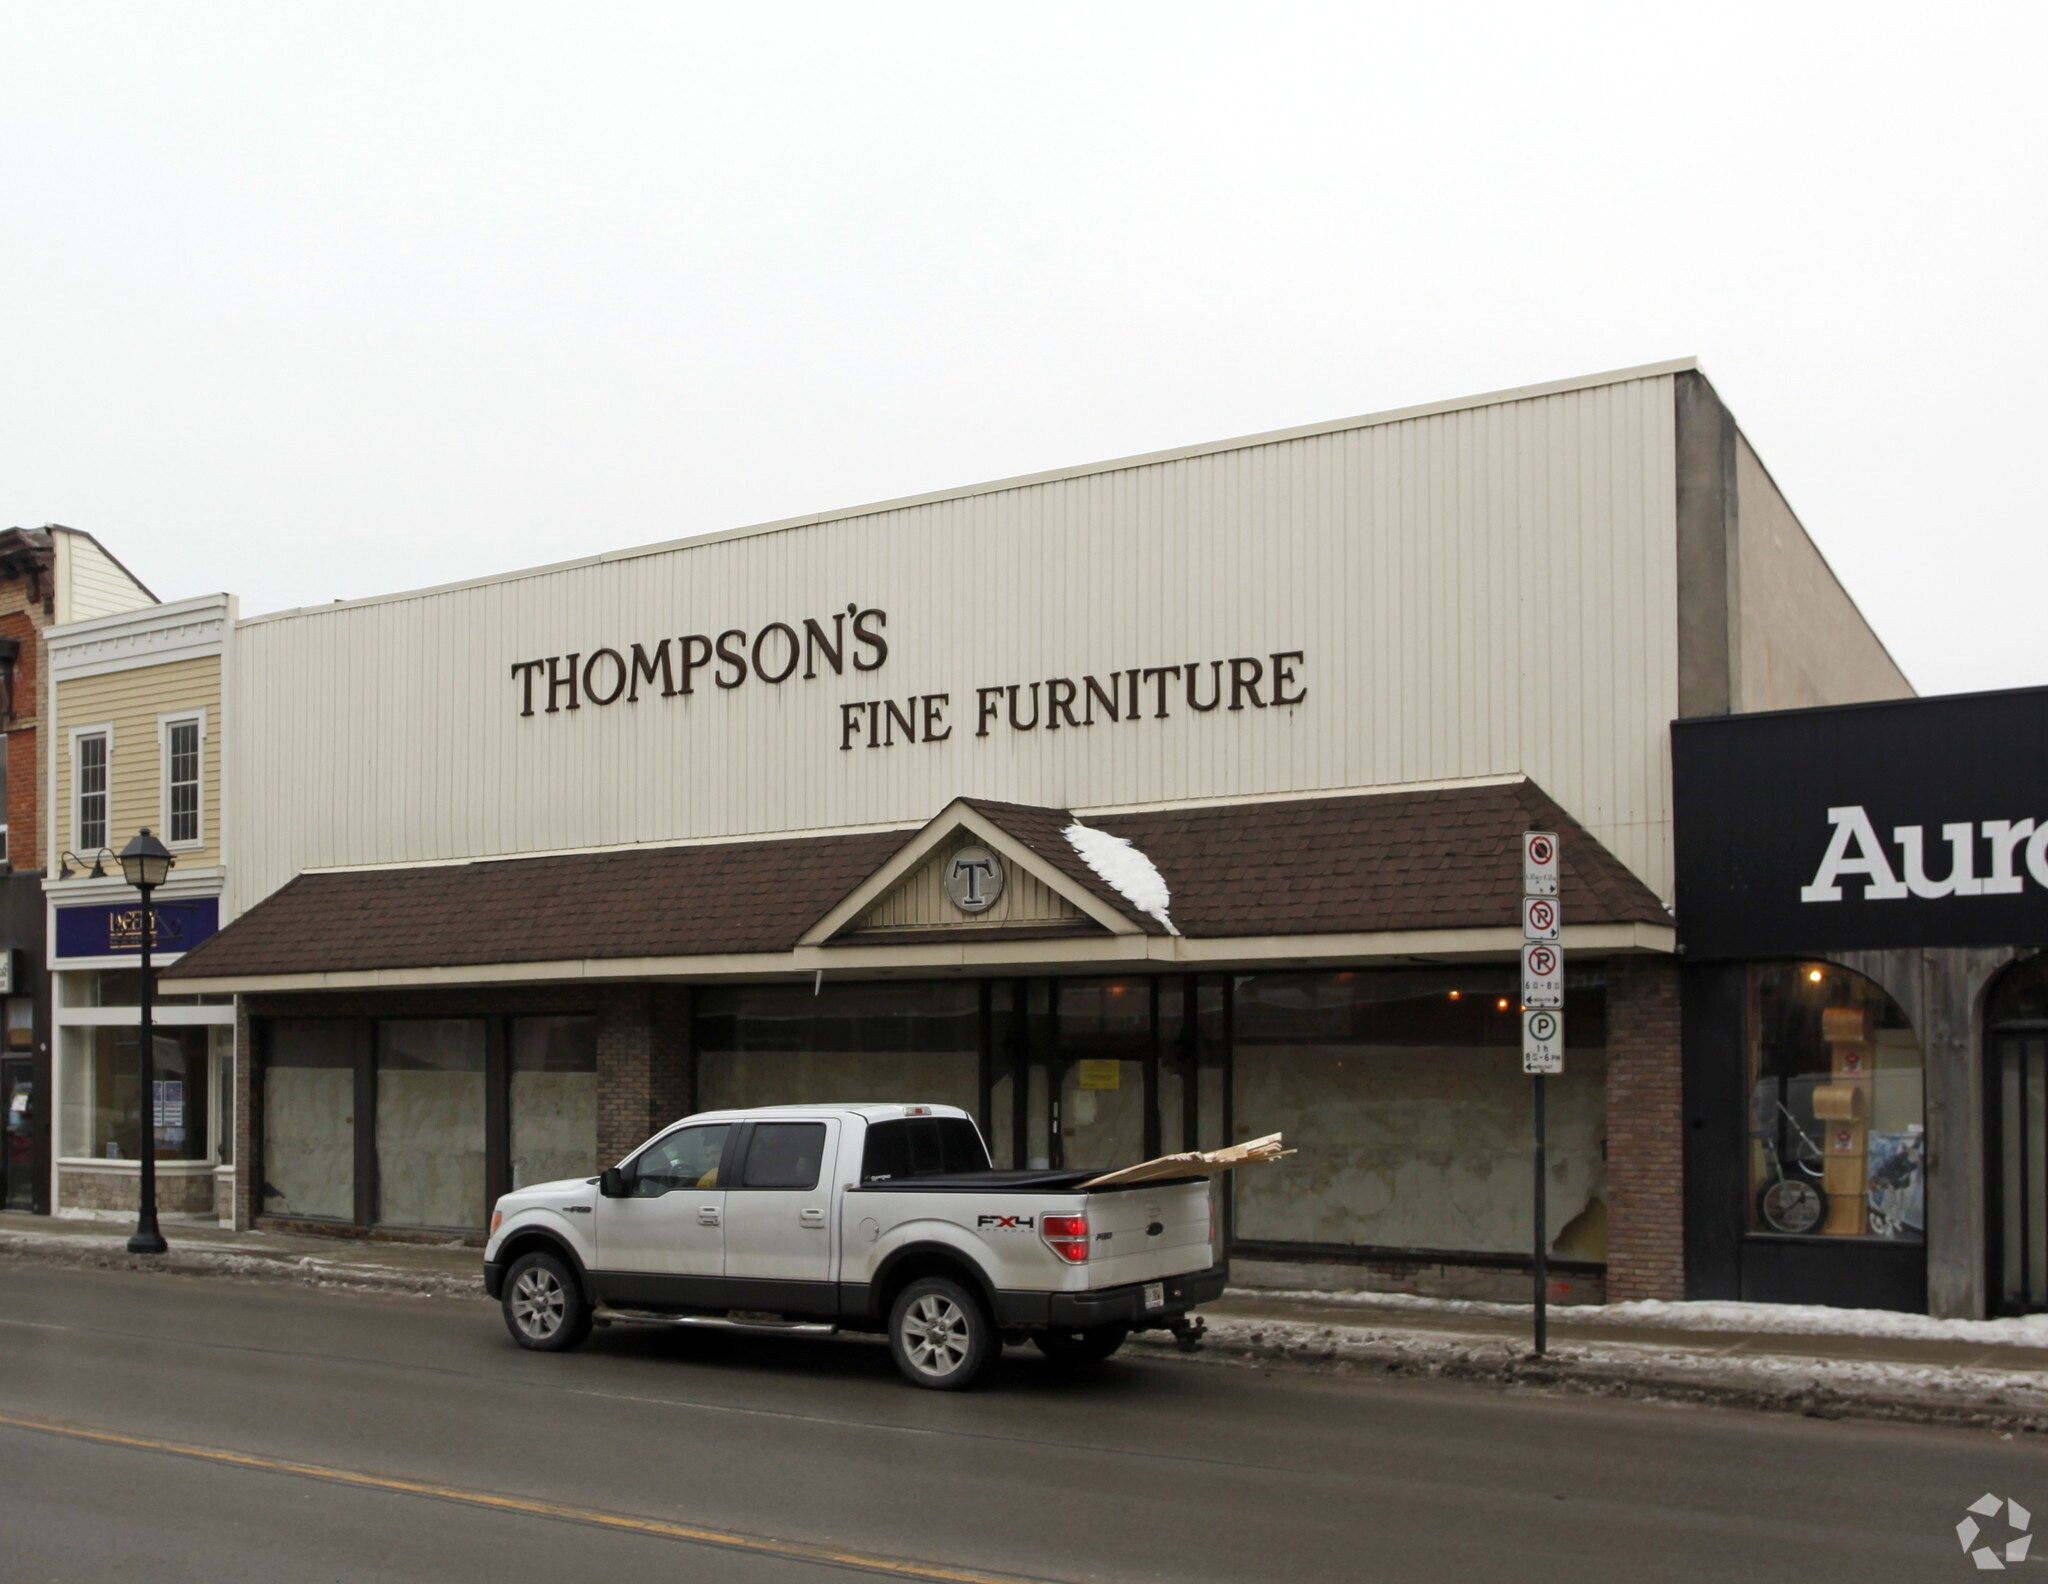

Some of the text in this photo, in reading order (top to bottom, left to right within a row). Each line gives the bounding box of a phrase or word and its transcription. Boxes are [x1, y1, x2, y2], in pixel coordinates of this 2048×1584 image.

[511, 602, 889, 717] THOMPSON'S
[839, 650, 1308, 750] FINE FURNITURE
[952, 859, 996, 906] T
[1537, 1018, 1550, 1034] P
[977, 1215, 1034, 1228] FX4
